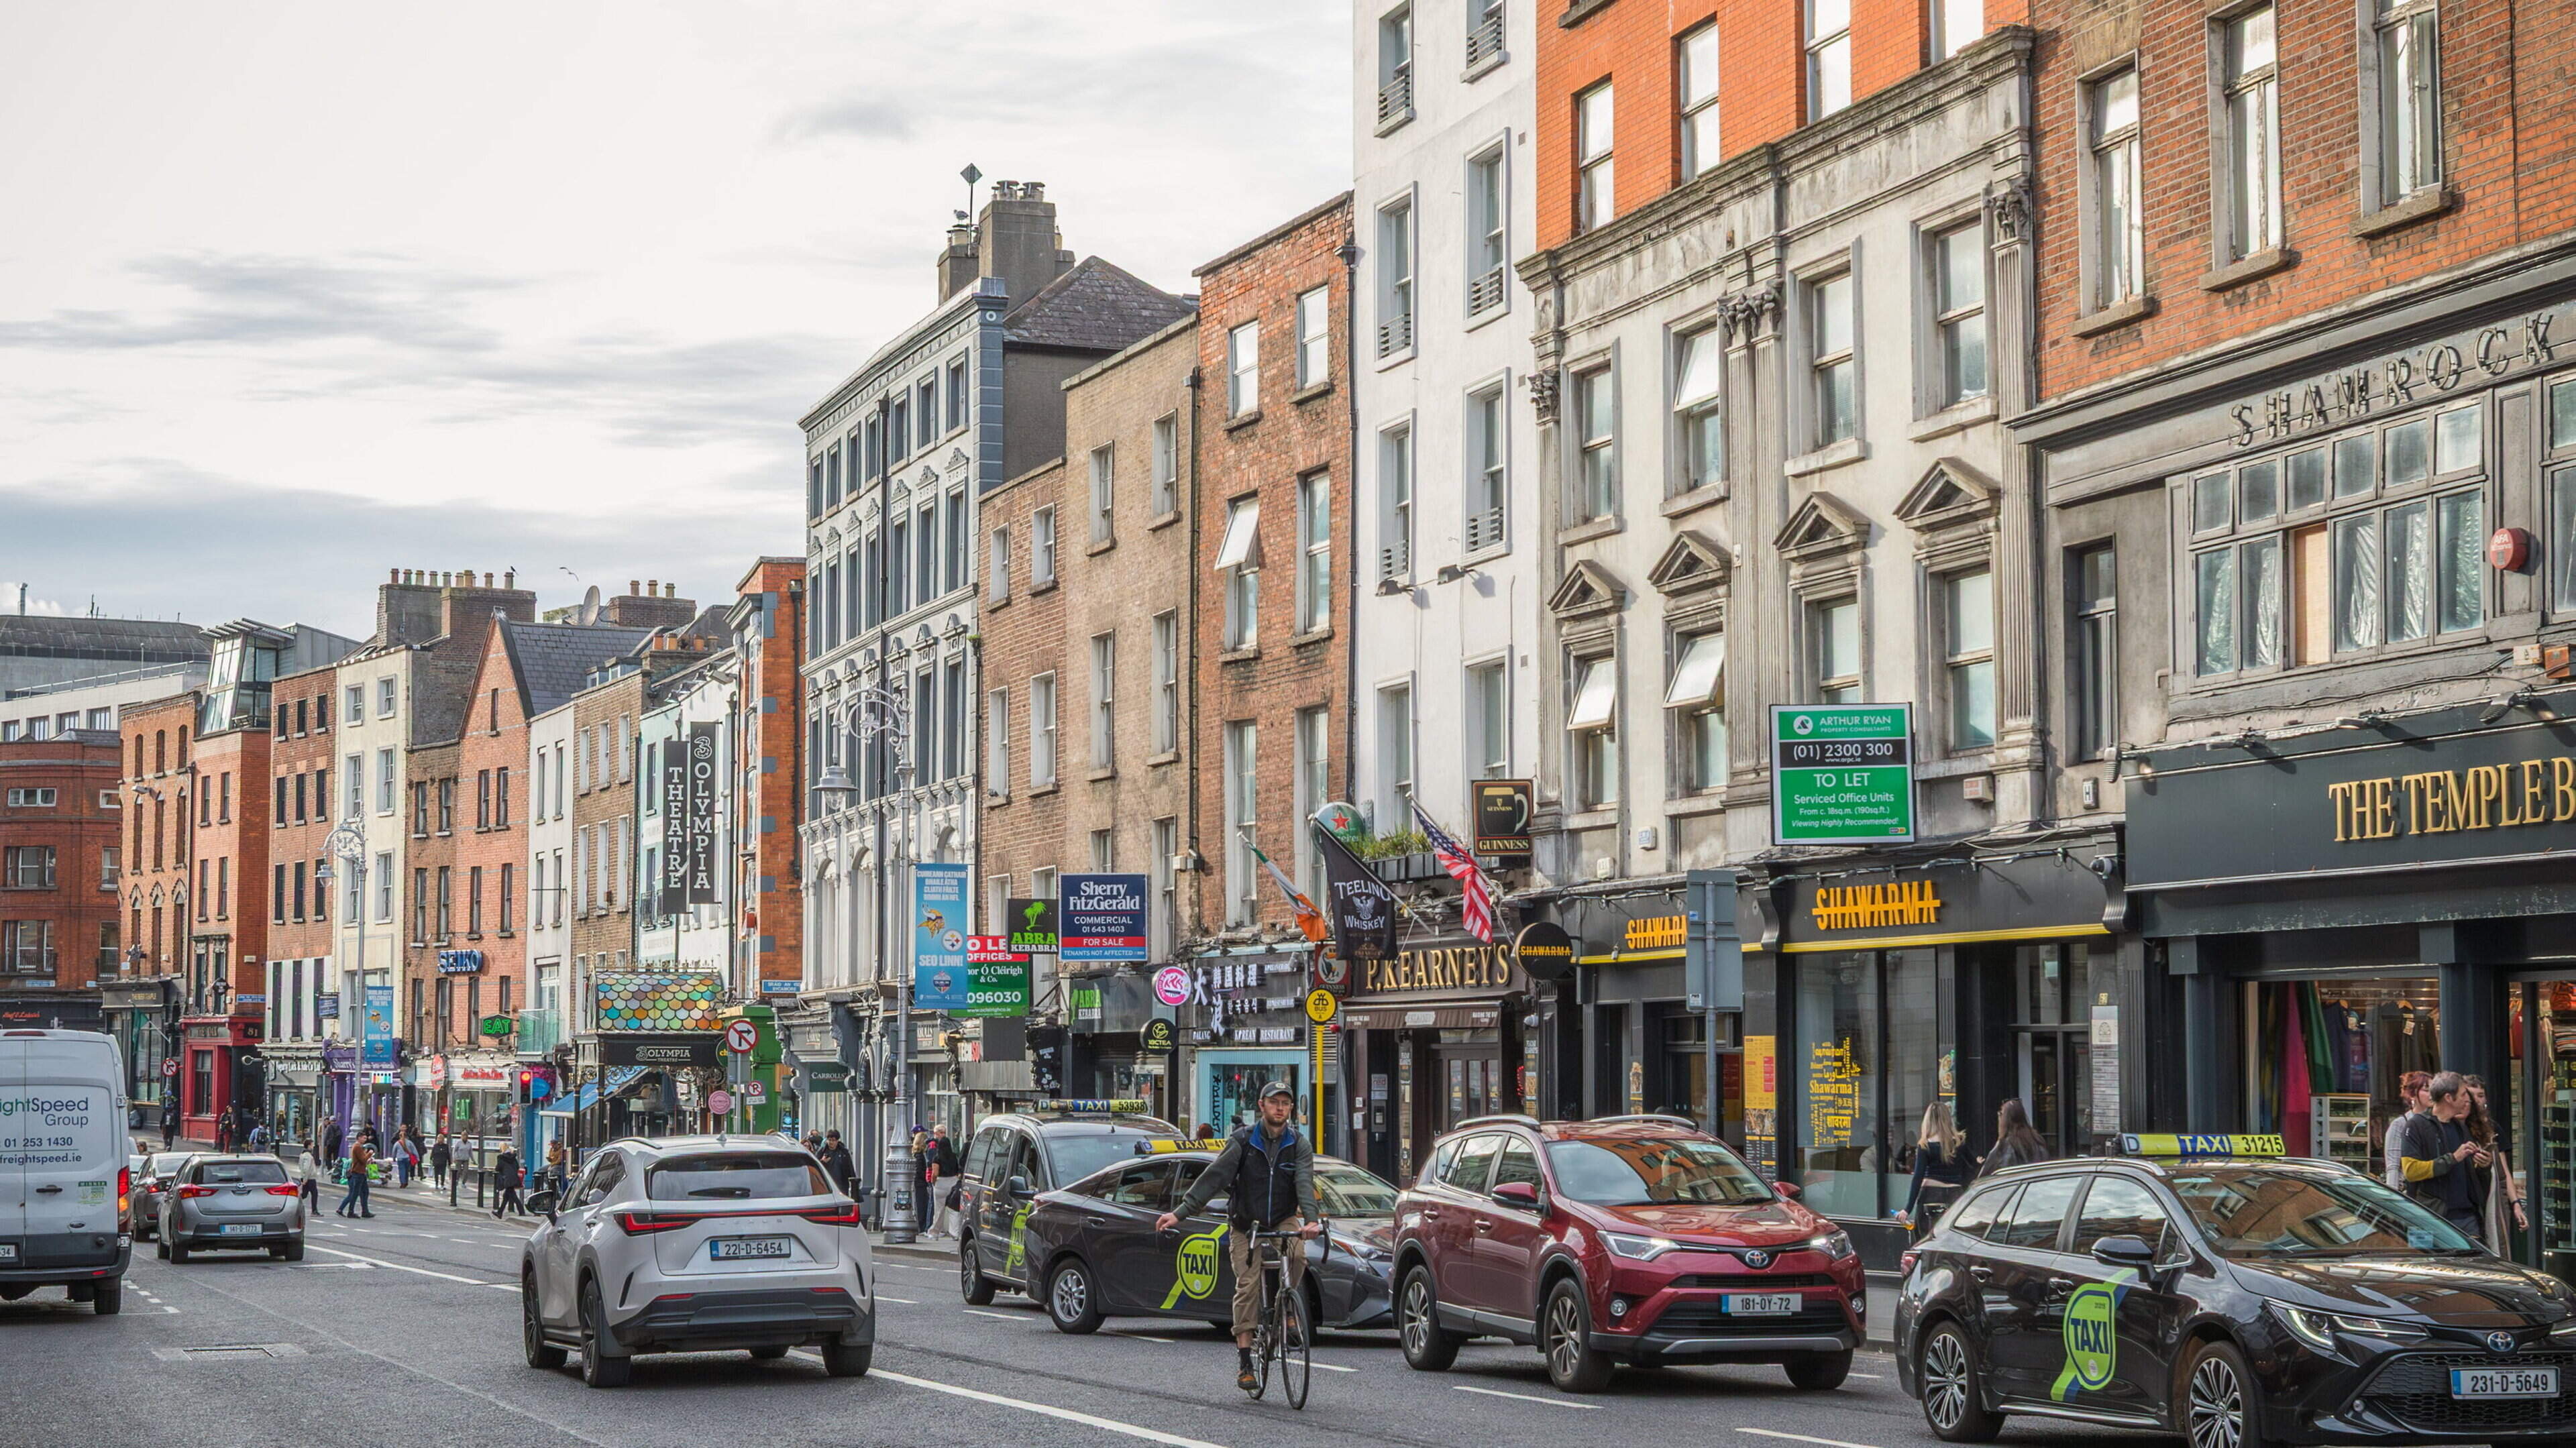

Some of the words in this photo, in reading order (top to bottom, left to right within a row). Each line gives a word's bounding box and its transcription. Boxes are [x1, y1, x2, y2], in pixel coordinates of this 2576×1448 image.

[2228, 313, 2553, 448] SHAMROCK
[2494, 534, 2509, 545] AFA
[1819, 716, 1861, 726] ARTHUR
[1863, 716, 1892, 724] RYAN
[1793, 744, 1820, 761] (01)
[1825, 744, 1862, 757] 2300
[1866, 743, 1893, 756] 300
[1813, 773, 1836, 787] TO
[1845, 772, 1870, 787] LET
[1794, 794, 1835, 804] Serviced
[1838, 793, 1867, 803] Office
[1870, 792, 1894, 802] Units
[2328, 777, 2395, 842] THE
[2402, 759, 2546, 836] TEMPLE
[2551, 757, 2576, 822] B
[667, 767, 684, 888] THEATRE
[693, 762, 712, 889] OLYMPIA
[1792, 820, 1819, 828] Viewing
[1821, 819, 1843, 828] Highly
[1845, 817, 1899, 826] Recommended!
[1479, 839, 1529, 850] GUINNESS
[1080, 881, 1128, 899] Sherry
[1069, 895, 1140, 911] FitzGerald
[1813, 879, 1941, 931] SHAWARMA
[1074, 916, 1132, 924] COMMERCIAL
[1344, 915, 1385, 930] WHISKEY
[1011, 932, 1058, 944] ABRA
[1625, 915, 1687, 950] SHAWAR
[967, 939, 981, 950] O
[987, 939, 1008, 950] LE
[1010, 944, 1058, 952] KEBABRA
[1519, 946, 1572, 956] SHAWARMA
[439, 950, 482, 972] SEIKO
[919, 954, 937, 966] SEO
[939, 954, 963, 966] LINN!
[967, 952, 1012, 961] OFFICES
[981, 964, 989, 975] Ó
[991, 965, 1023, 977] Cléirigh
[1366, 943, 1509, 992] P.KEARNEY'S
[967, 991, 1022, 1003] 096030
[1079, 989, 1102, 1007] ABRA
[1078, 1008, 1102, 1019] KEBABRA
[247, 1027, 258, 1037] 81
[483, 1019, 511, 1034] EAT
[1234, 1028, 1256, 1041] KOREAN
[1260, 1028, 1295, 1042] RESTAURANT
[1809, 1079, 1852, 1094] Shawarma
[455, 1099, 470, 1121] EAT
[1040, 1101, 1048, 1110] D
[1077, 1100, 1107, 1111] TAXI
[1118, 1101, 1146, 1111] 53938
[45, 1113, 89, 1127] Group
[4, 1138, 17, 1148] 01
[23, 1137, 43, 1148] 253
[47, 1137, 73, 1147] 1430
[1144, 1141, 1152, 1150] D
[1177, 1141, 1205, 1150] TAXI
[2128, 1137, 2140, 1153] D
[2180, 1135, 2231, 1153] TAXI
[2241, 1135, 2282, 1154] 31215
[724, 1242, 783, 1256] 221-D-6454
[1182, 1253, 1213, 1276] TAXI
[1741, 1297, 1790, 1311] 181-OY-72
[2070, 1317, 2109, 1355] TAXI
[2471, 1374, 2548, 1393] 231-D-5649
